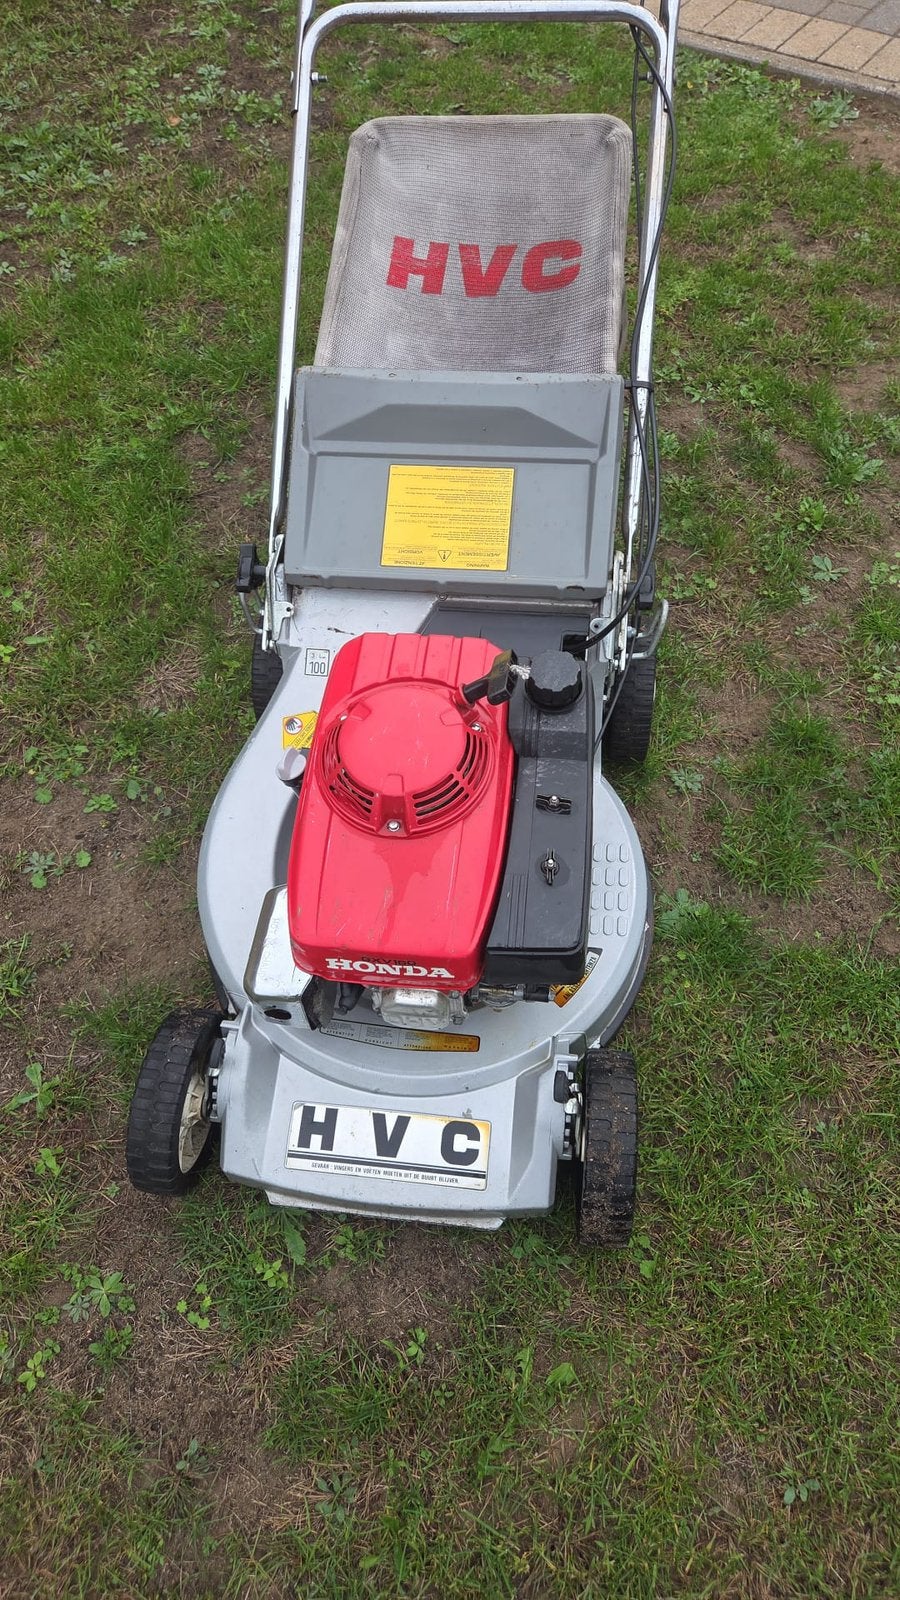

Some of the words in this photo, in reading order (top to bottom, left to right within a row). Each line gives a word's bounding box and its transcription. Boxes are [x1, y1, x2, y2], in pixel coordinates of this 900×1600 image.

[386, 235, 582, 298] HVC
[309, 661, 326, 674] 100
[325, 957, 455, 979] HONDA
